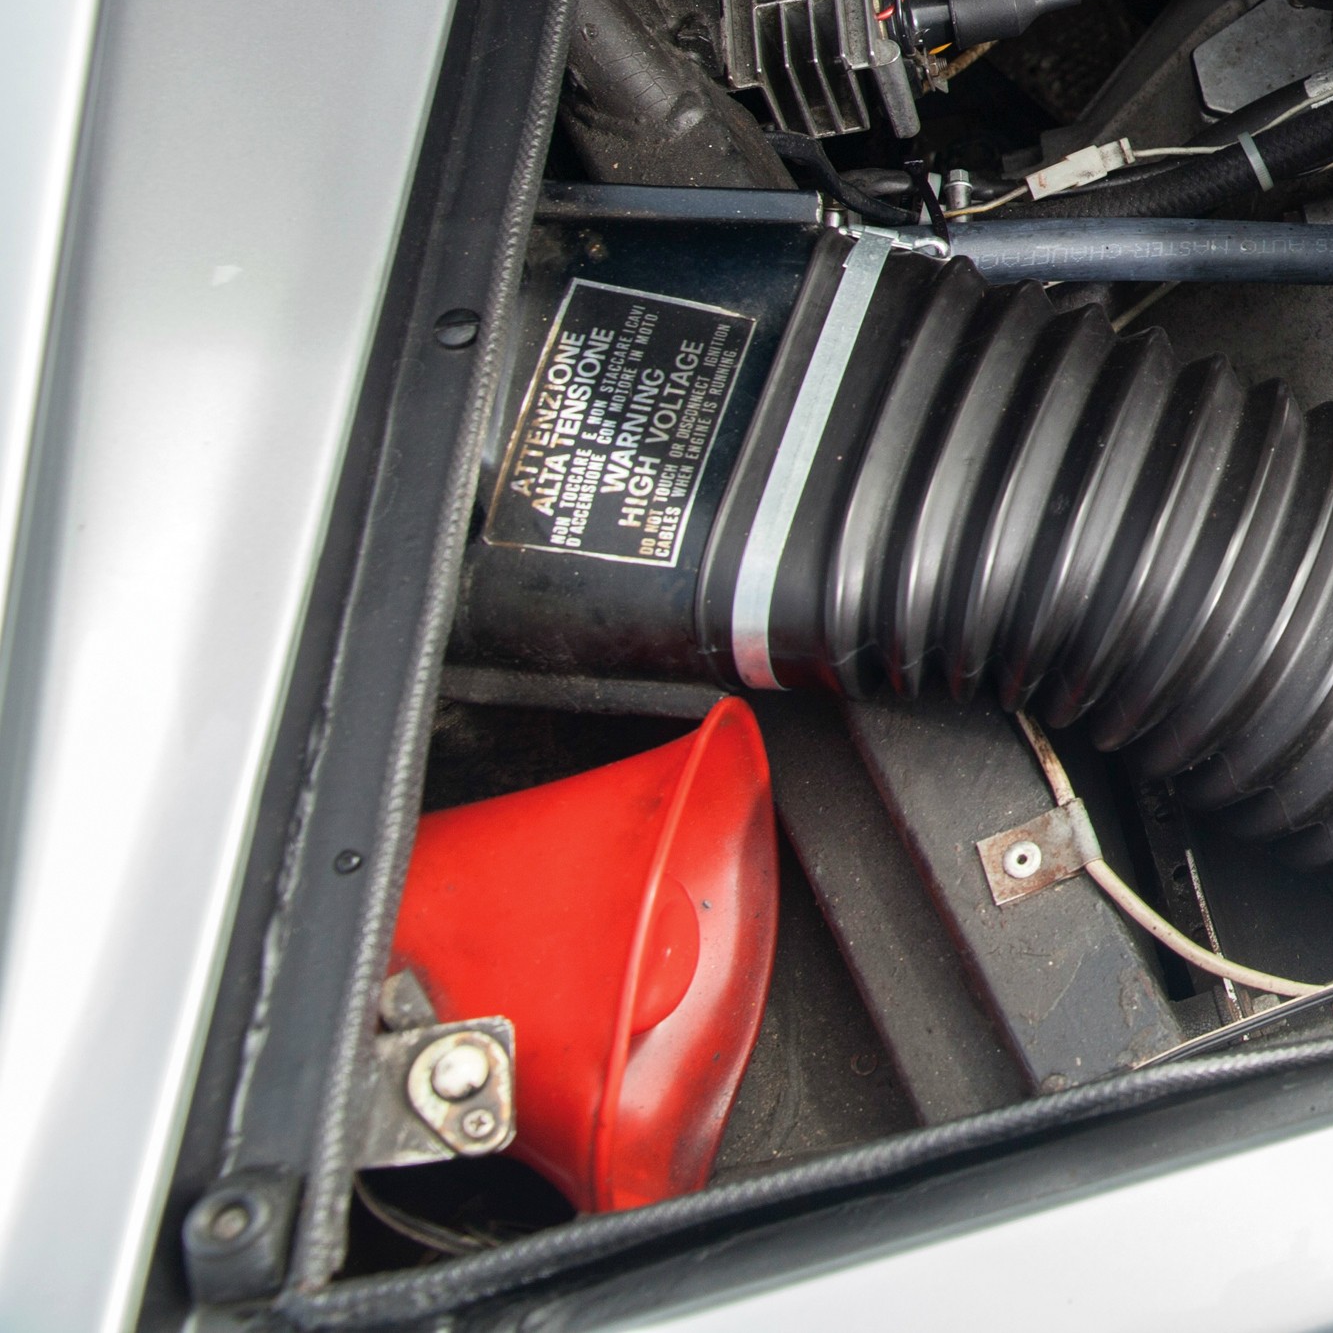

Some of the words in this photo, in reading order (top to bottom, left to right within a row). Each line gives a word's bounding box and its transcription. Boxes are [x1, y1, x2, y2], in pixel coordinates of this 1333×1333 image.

[1238, 239, 1305, 256] AUTO
[625, 303, 646, 329] CAVI
[634, 307, 660, 345] MOTO.
[598, 334, 633, 394] STACCARE
[628, 348, 645, 362] IN
[703, 322, 731, 368] IGNITION
[548, 324, 616, 451] TENSIONE
[609, 365, 638, 413] MOTORE
[708, 345, 739, 396] RUNNING.
[507, 328, 586, 497] ATTENZIONE
[587, 398, 610, 425] NON
[676, 373, 712, 439] DISCONNECT
[702, 400, 718, 414] IS
[582, 430, 599, 440] E
[596, 418, 618, 445] CON
[598, 364, 667, 496] WARNING
[615, 454, 663, 529] HIGH
[644, 337, 705, 447] VOLTAGE
[669, 442, 687, 458] OR
[683, 416, 712, 460] ENGINE
[526, 449, 573, 517] ALTA
[559, 447, 593, 509] TOCCARE
[653, 463, 679, 503] TOUCH
[670, 464, 695, 498] WHEN
[548, 515, 572, 544] NON
[644, 508, 665, 533] NOT
[651, 504, 685, 558] CABLES
[637, 536, 656, 555] DO
